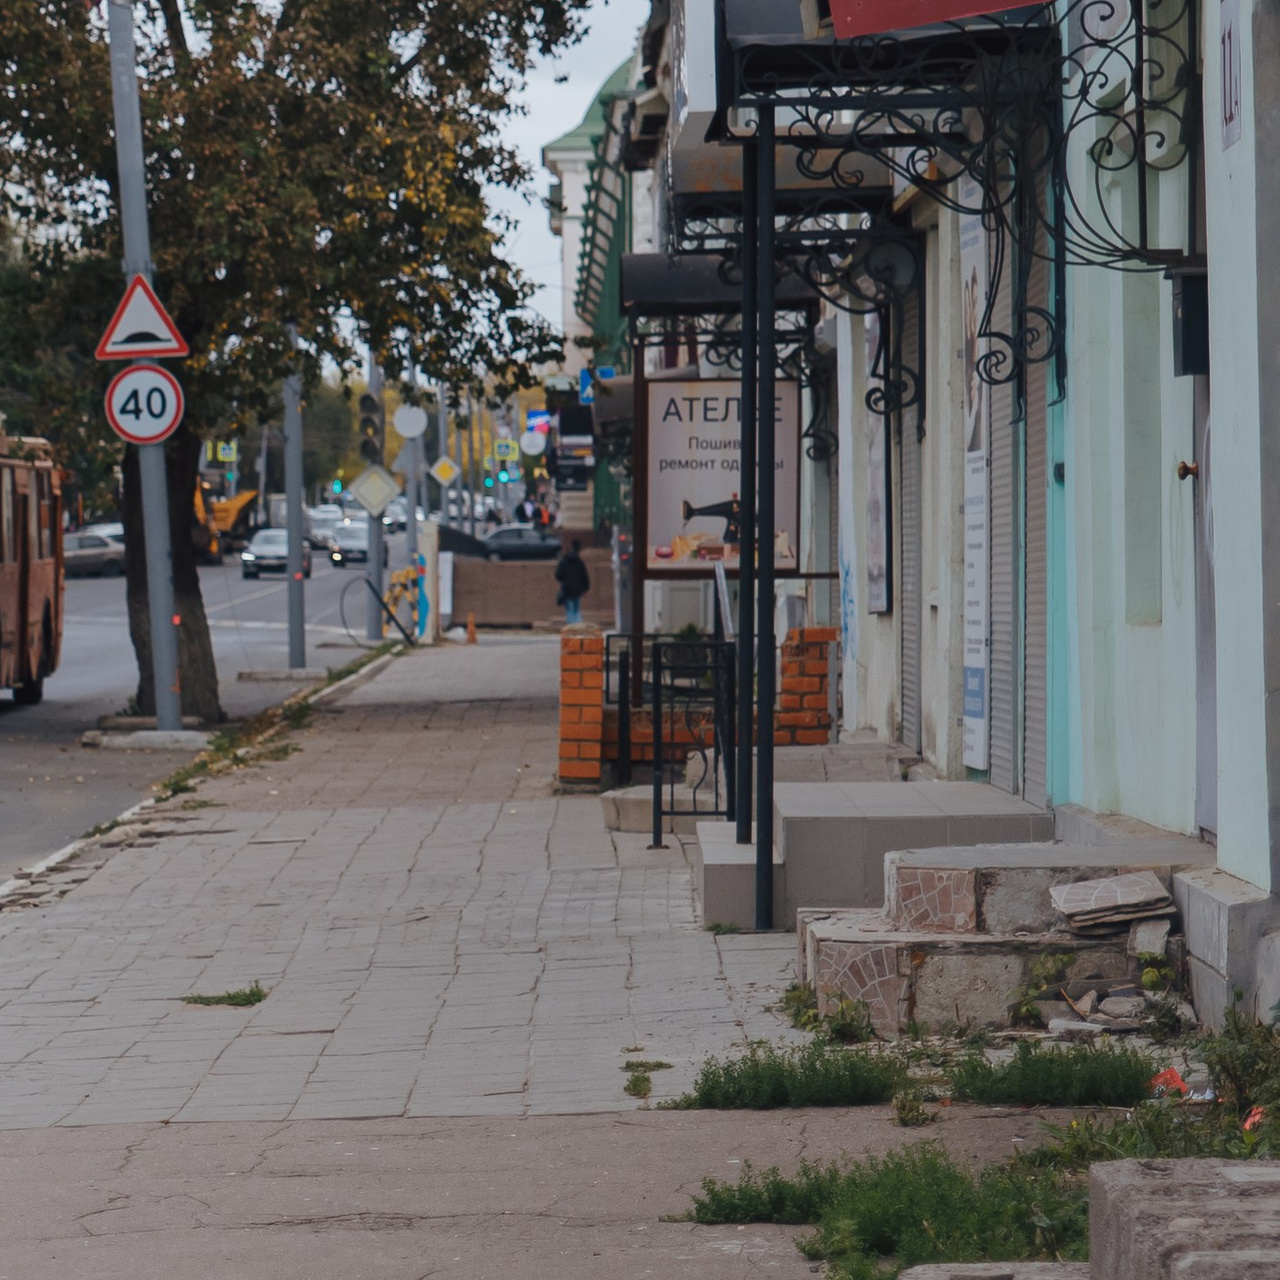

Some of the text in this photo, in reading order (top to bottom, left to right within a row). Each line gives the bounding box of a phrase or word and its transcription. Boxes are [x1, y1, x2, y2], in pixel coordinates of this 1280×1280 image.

[119, 387, 167, 421] 40
[662, 396, 783, 422] АТЕЛЕ
[659, 459, 716, 473] ремонт
